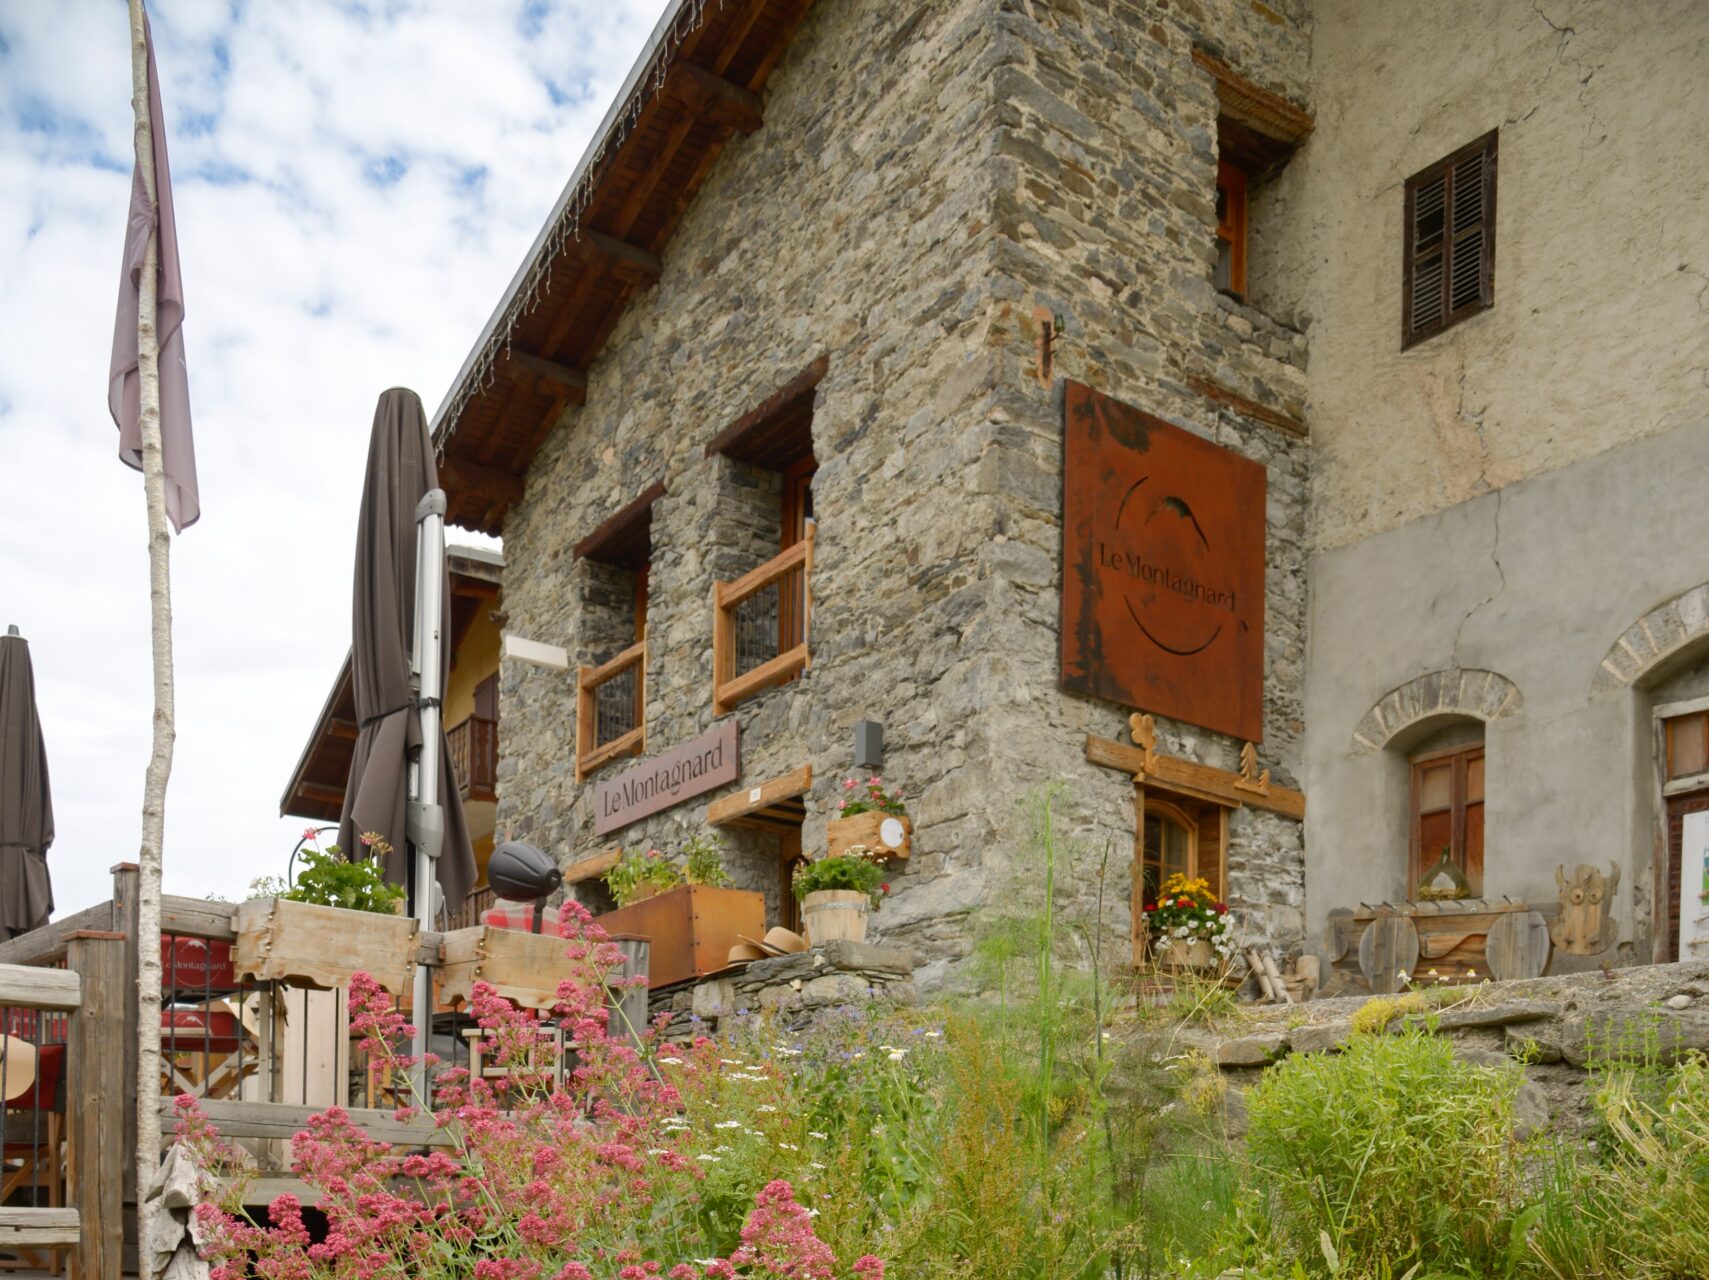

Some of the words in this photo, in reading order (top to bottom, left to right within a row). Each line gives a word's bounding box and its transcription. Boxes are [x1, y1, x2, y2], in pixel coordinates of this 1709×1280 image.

[1100, 542, 1122, 571] Le
[1125, 551, 1235, 612] Montagnard
[603, 791, 621, 817] Le
[622, 738, 722, 807] Montagnard
